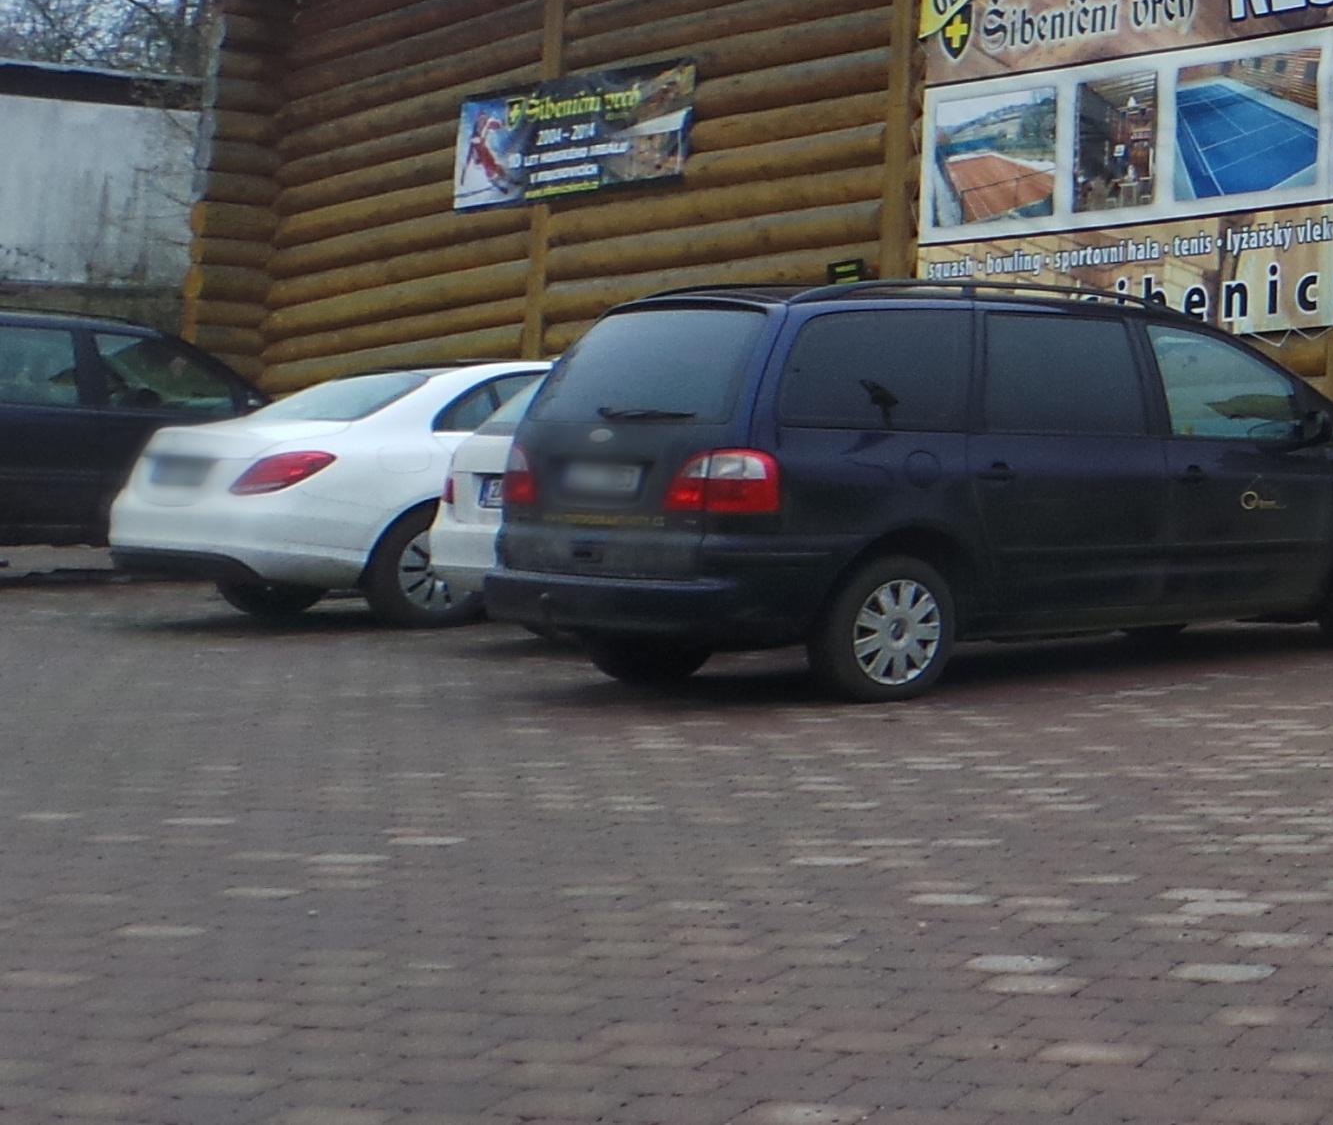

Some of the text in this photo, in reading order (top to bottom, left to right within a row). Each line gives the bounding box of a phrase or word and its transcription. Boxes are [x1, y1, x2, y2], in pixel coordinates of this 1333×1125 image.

[928, 259, 973, 280] squash
[985, 252, 1041, 275] bowling
[1053, 241, 1125, 270] sportovní
[1127, 237, 1160, 262] hala
[1173, 230, 1212, 257] tenis
[1225, 221, 1293, 256] lyžařský
[1296, 216, 1333, 242] vlek
